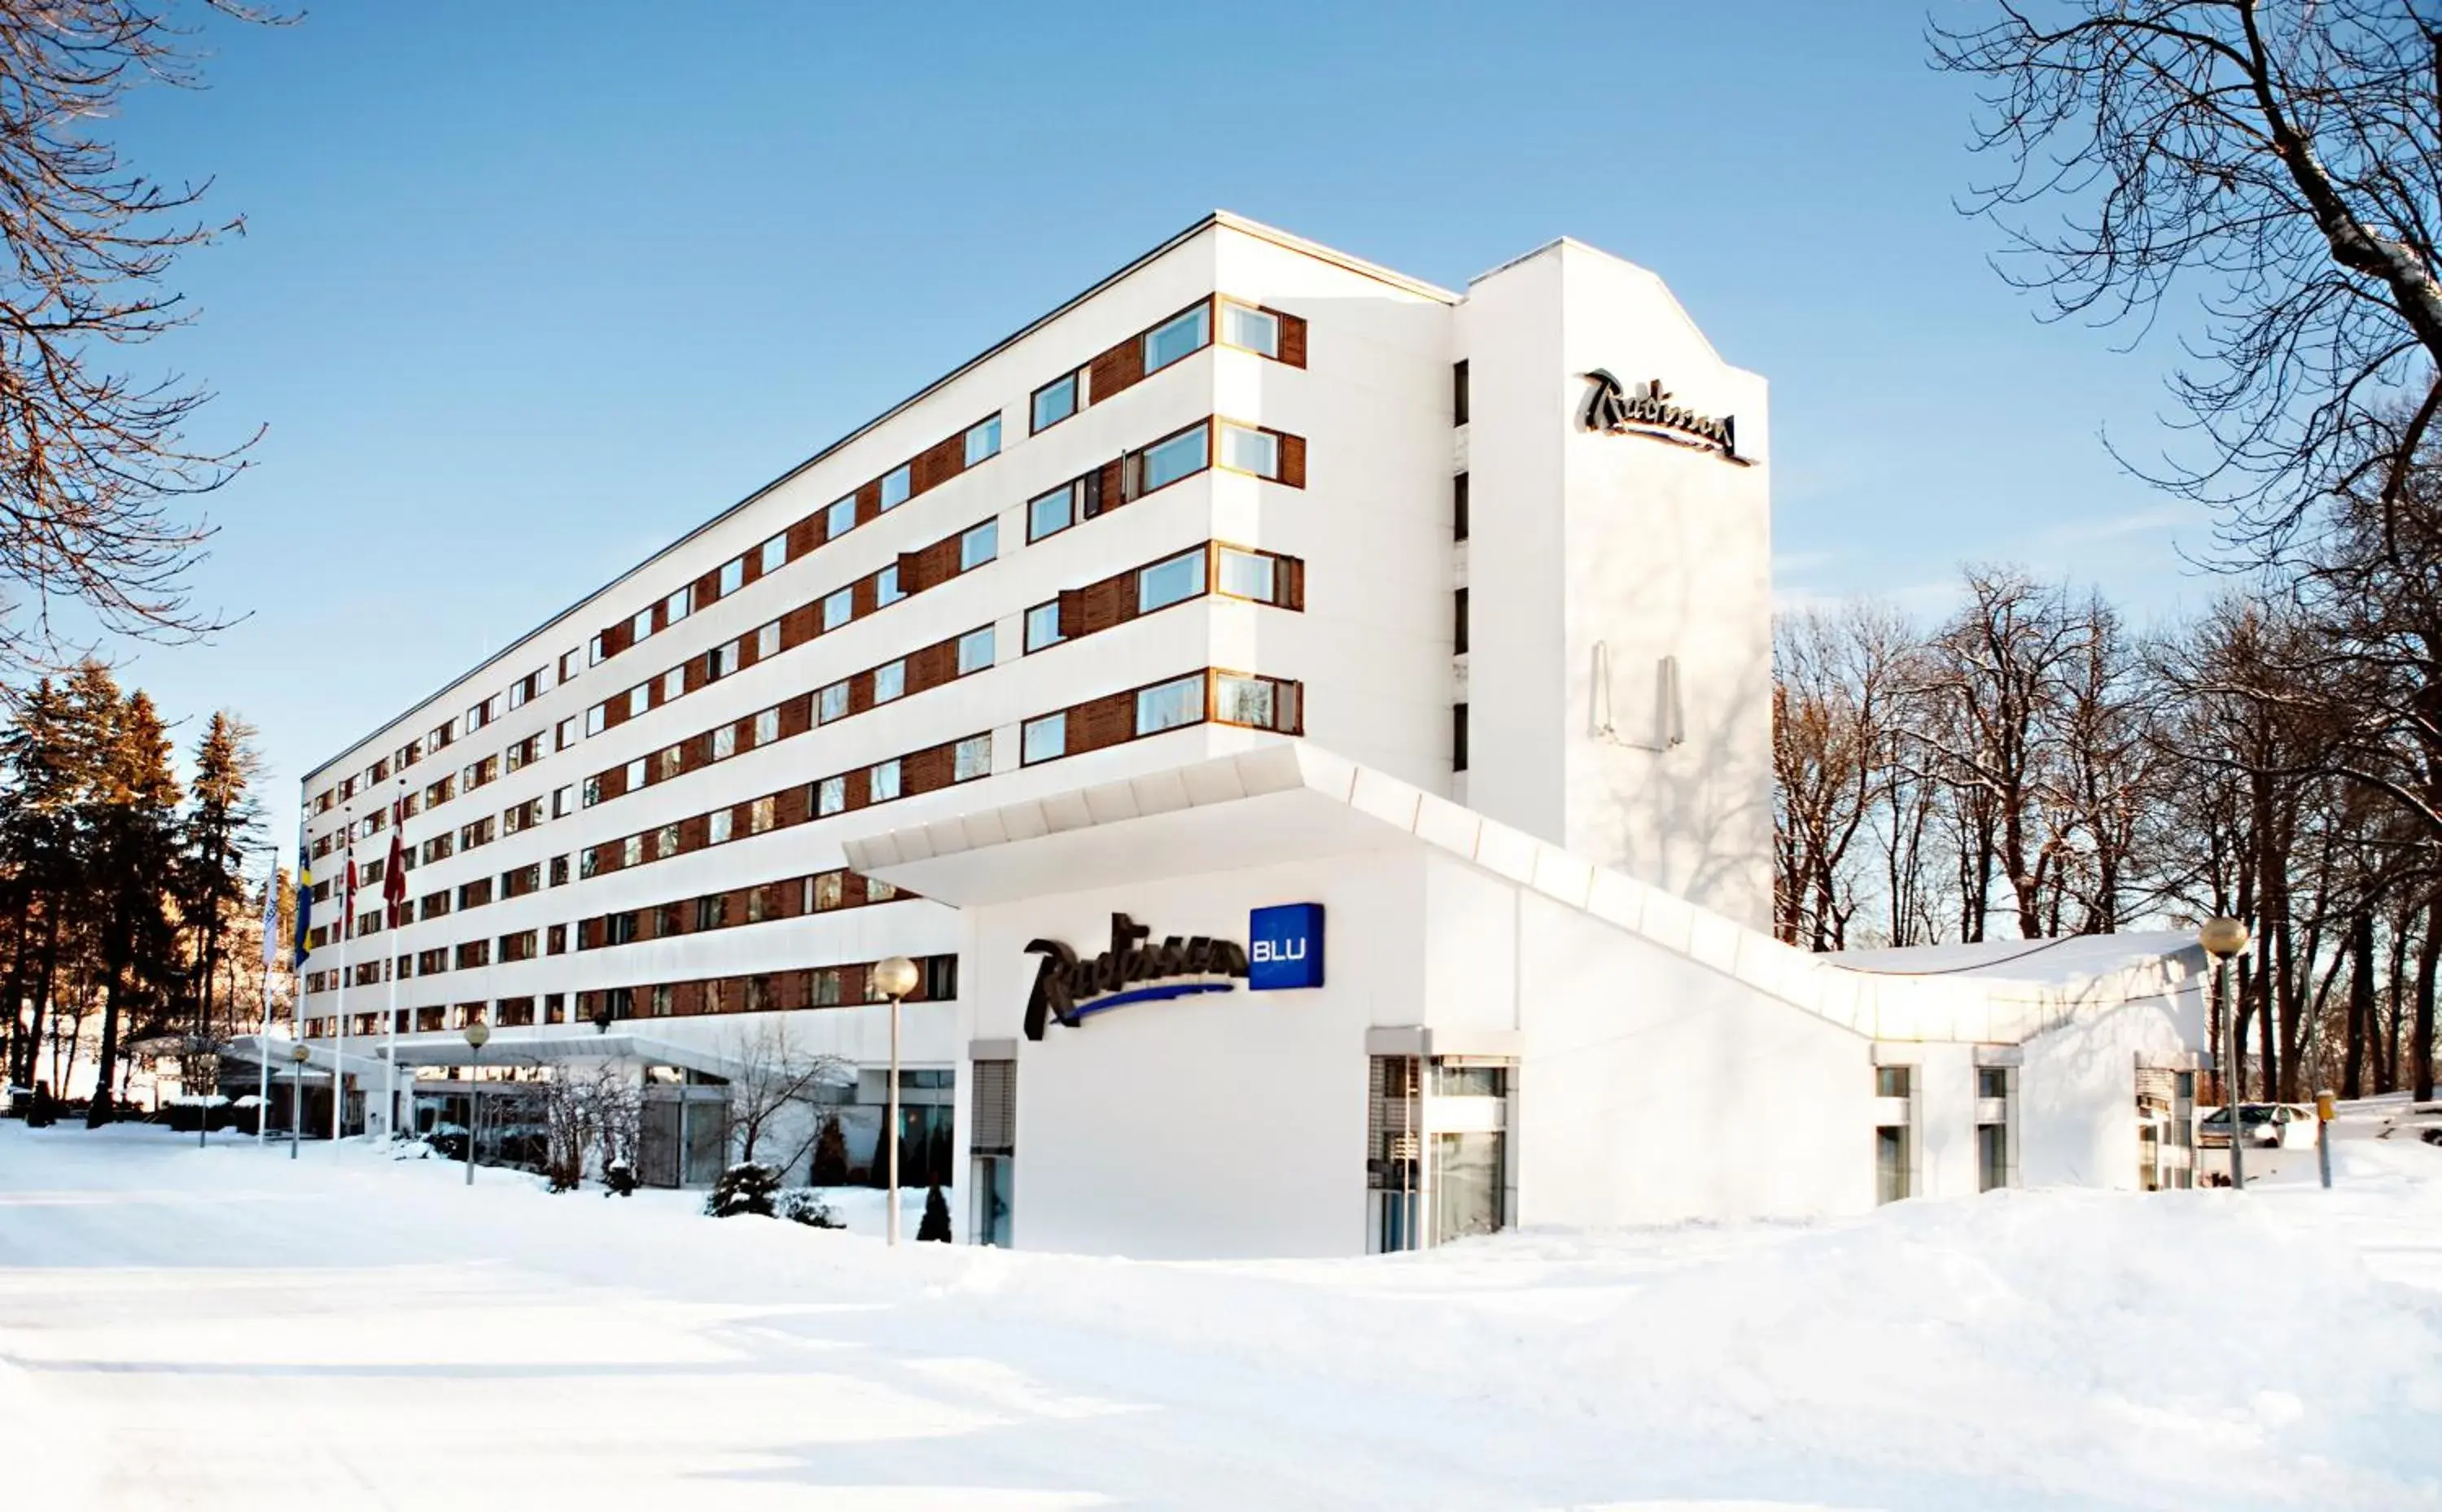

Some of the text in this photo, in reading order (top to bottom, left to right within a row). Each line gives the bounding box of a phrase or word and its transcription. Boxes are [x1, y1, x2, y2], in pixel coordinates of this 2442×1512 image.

[1582, 368, 1737, 457] Radisson
[1024, 912, 1306, 1041] Radisson BLU
